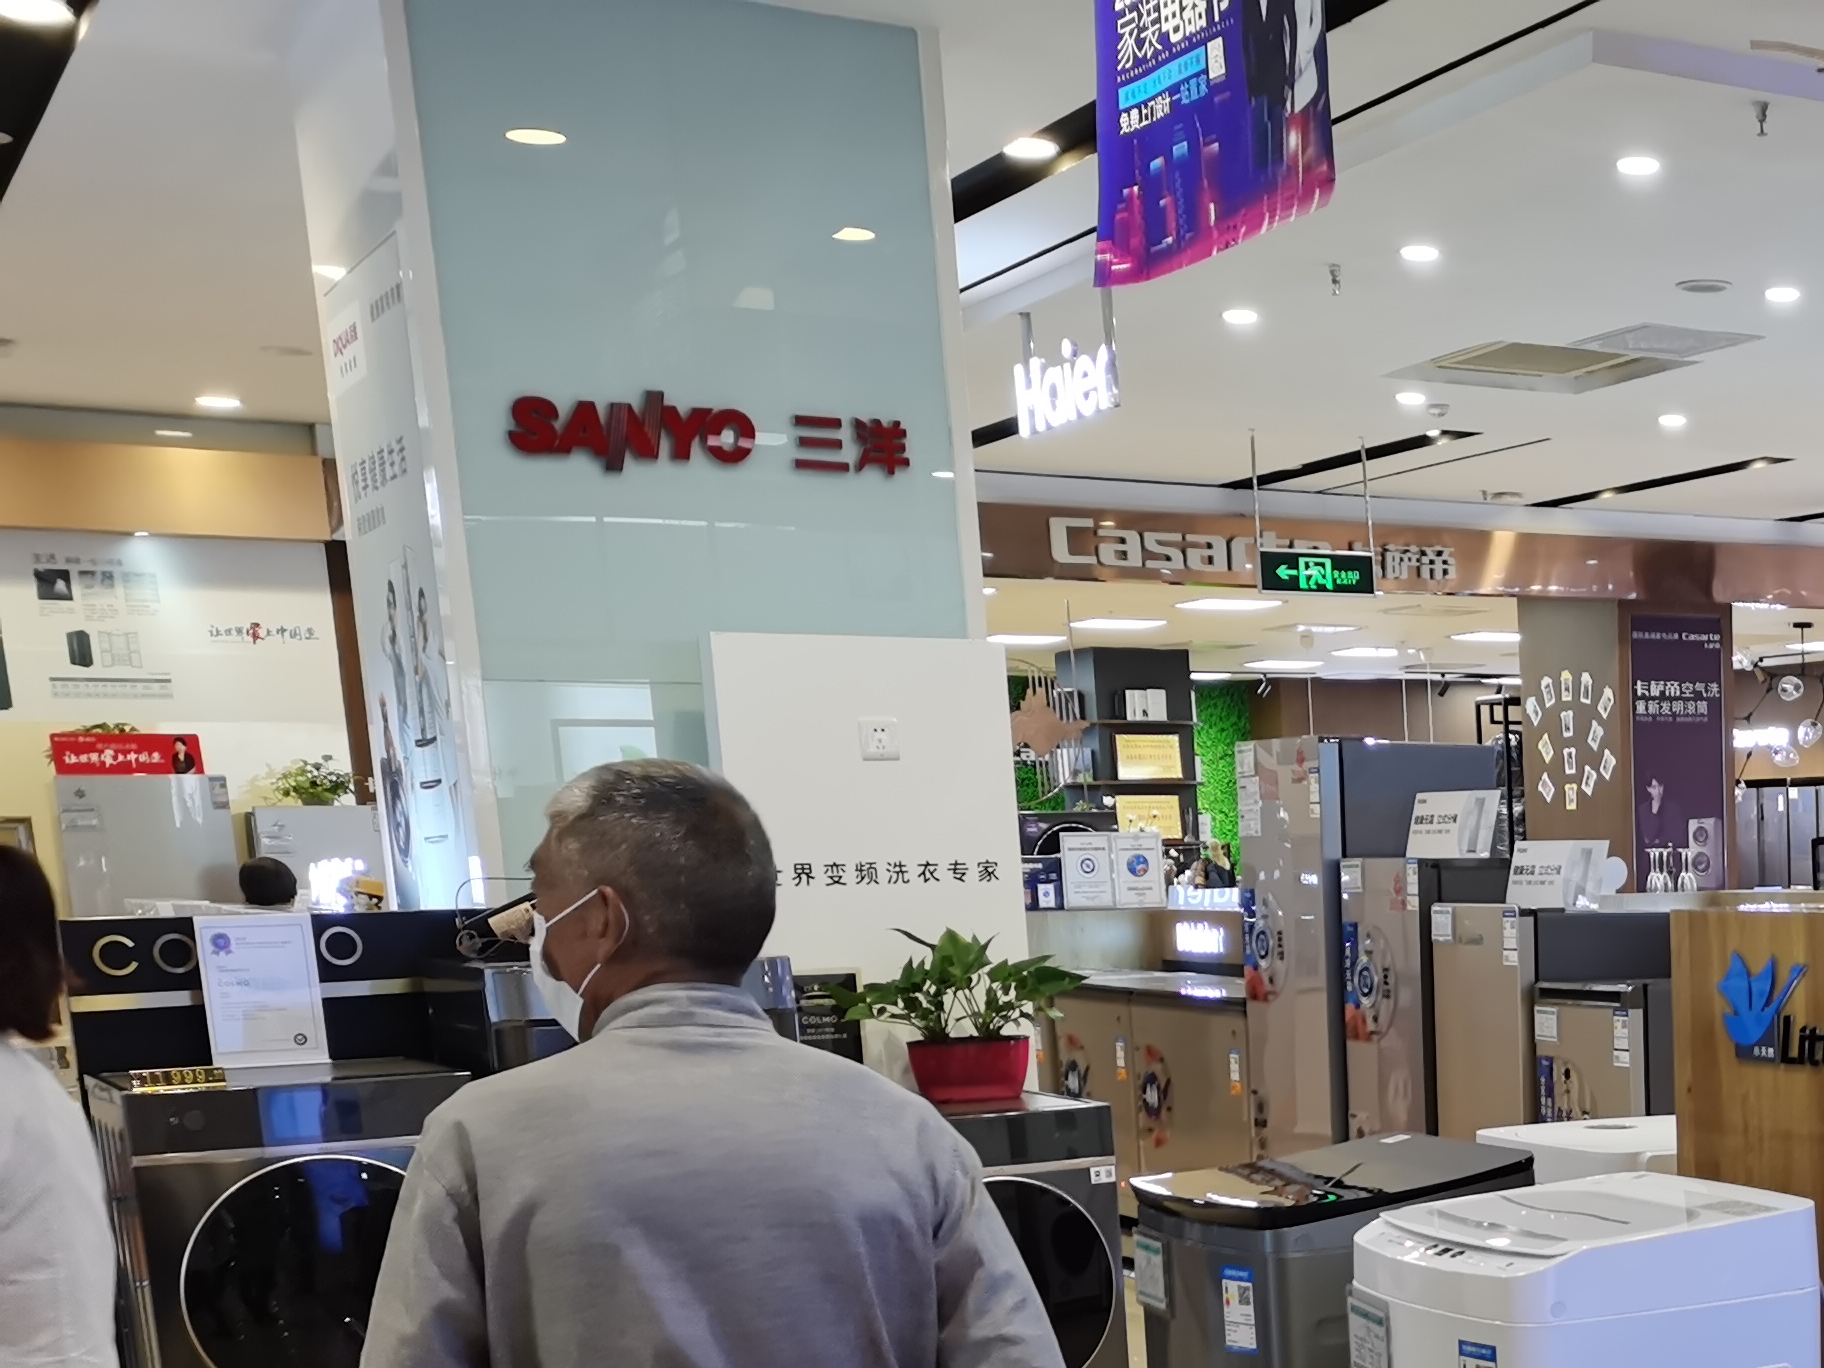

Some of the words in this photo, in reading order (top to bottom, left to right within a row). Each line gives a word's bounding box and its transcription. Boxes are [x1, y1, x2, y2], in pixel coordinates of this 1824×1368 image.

[1013, 337, 1117, 439] Haier
[508, 390, 756, 472] SANYO
[793, 414, 911, 476] 三洋
[1336, 577, 1358, 586] EXIT
[1681, 632, 1721, 641] Casarte
[1634, 680, 1720, 698] 卡萨帝空气洗
[1635, 700, 1709, 716] 重新发明滚筒
[92, 926, 363, 976] COO
